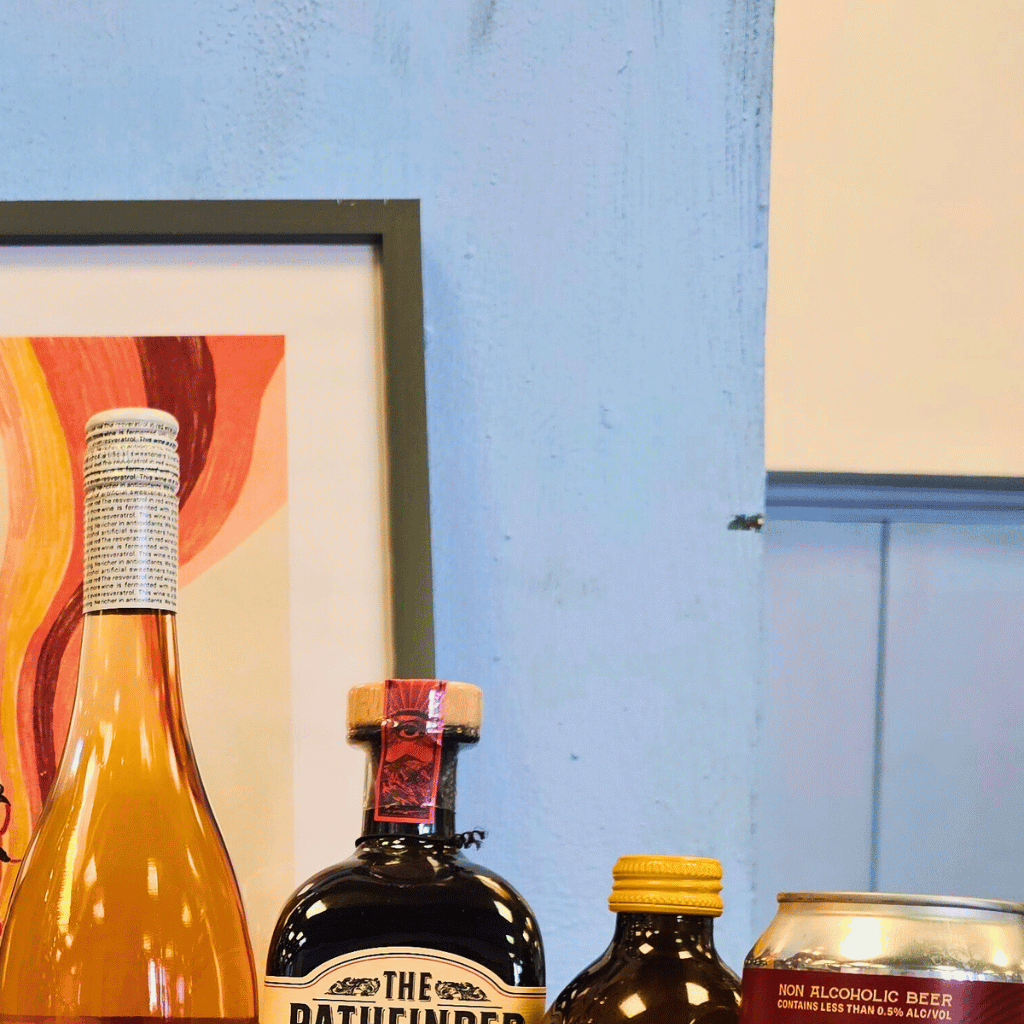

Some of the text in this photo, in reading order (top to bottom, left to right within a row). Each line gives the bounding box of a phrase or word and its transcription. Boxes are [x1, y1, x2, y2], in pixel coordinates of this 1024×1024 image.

[383, 970, 432, 1002] THE
[779, 983, 953, 1007] NON ALCOHOLIC BEER
[777, 999, 952, 1020] CONTAINS LESS THAN 0.5% ALC/VOL
